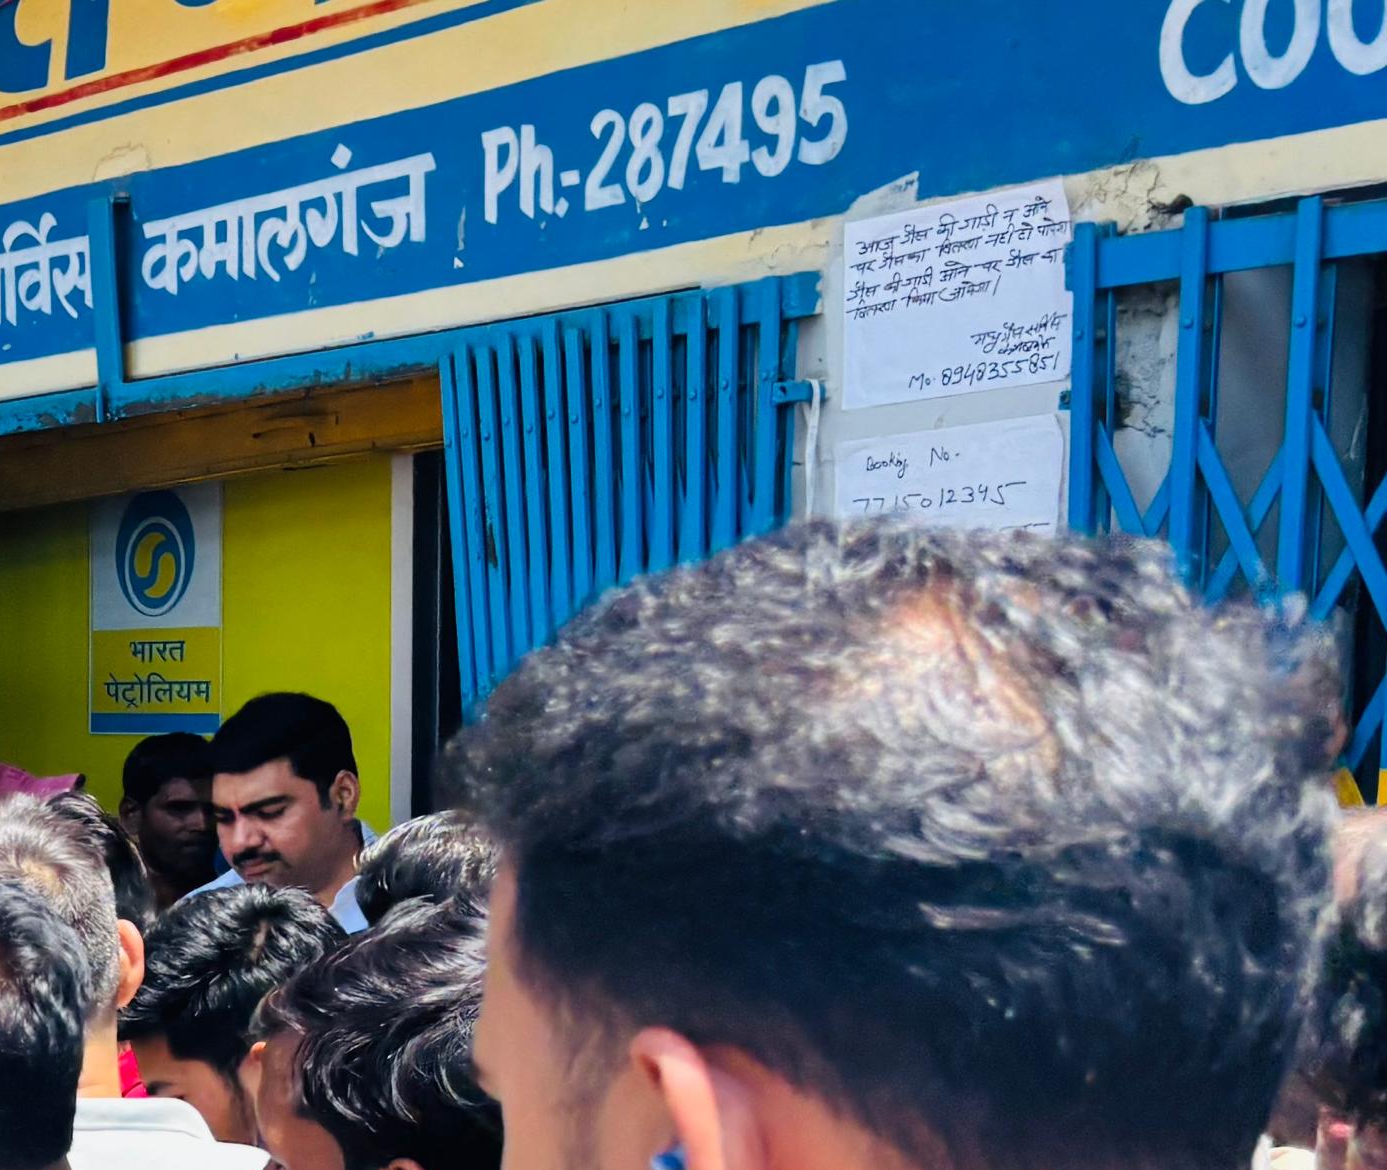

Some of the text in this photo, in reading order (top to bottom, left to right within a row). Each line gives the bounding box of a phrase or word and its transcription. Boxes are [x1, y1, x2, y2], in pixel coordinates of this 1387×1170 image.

[141, 143, 437, 295] कमालगंज
[855, 235, 900, 255] आज
[937, 213, 960, 237] की
[1003, 208, 1019, 222] न
[1023, 195, 1052, 218] आने
[850, 259, 877, 275] पर
[1014, 221, 1034, 241] हो
[940, 260, 973, 282] आने
[974, 259, 1003, 273] पर
[129, 640, 185, 663] भारत
[103, 672, 212, 708] पेट्रोलियम
